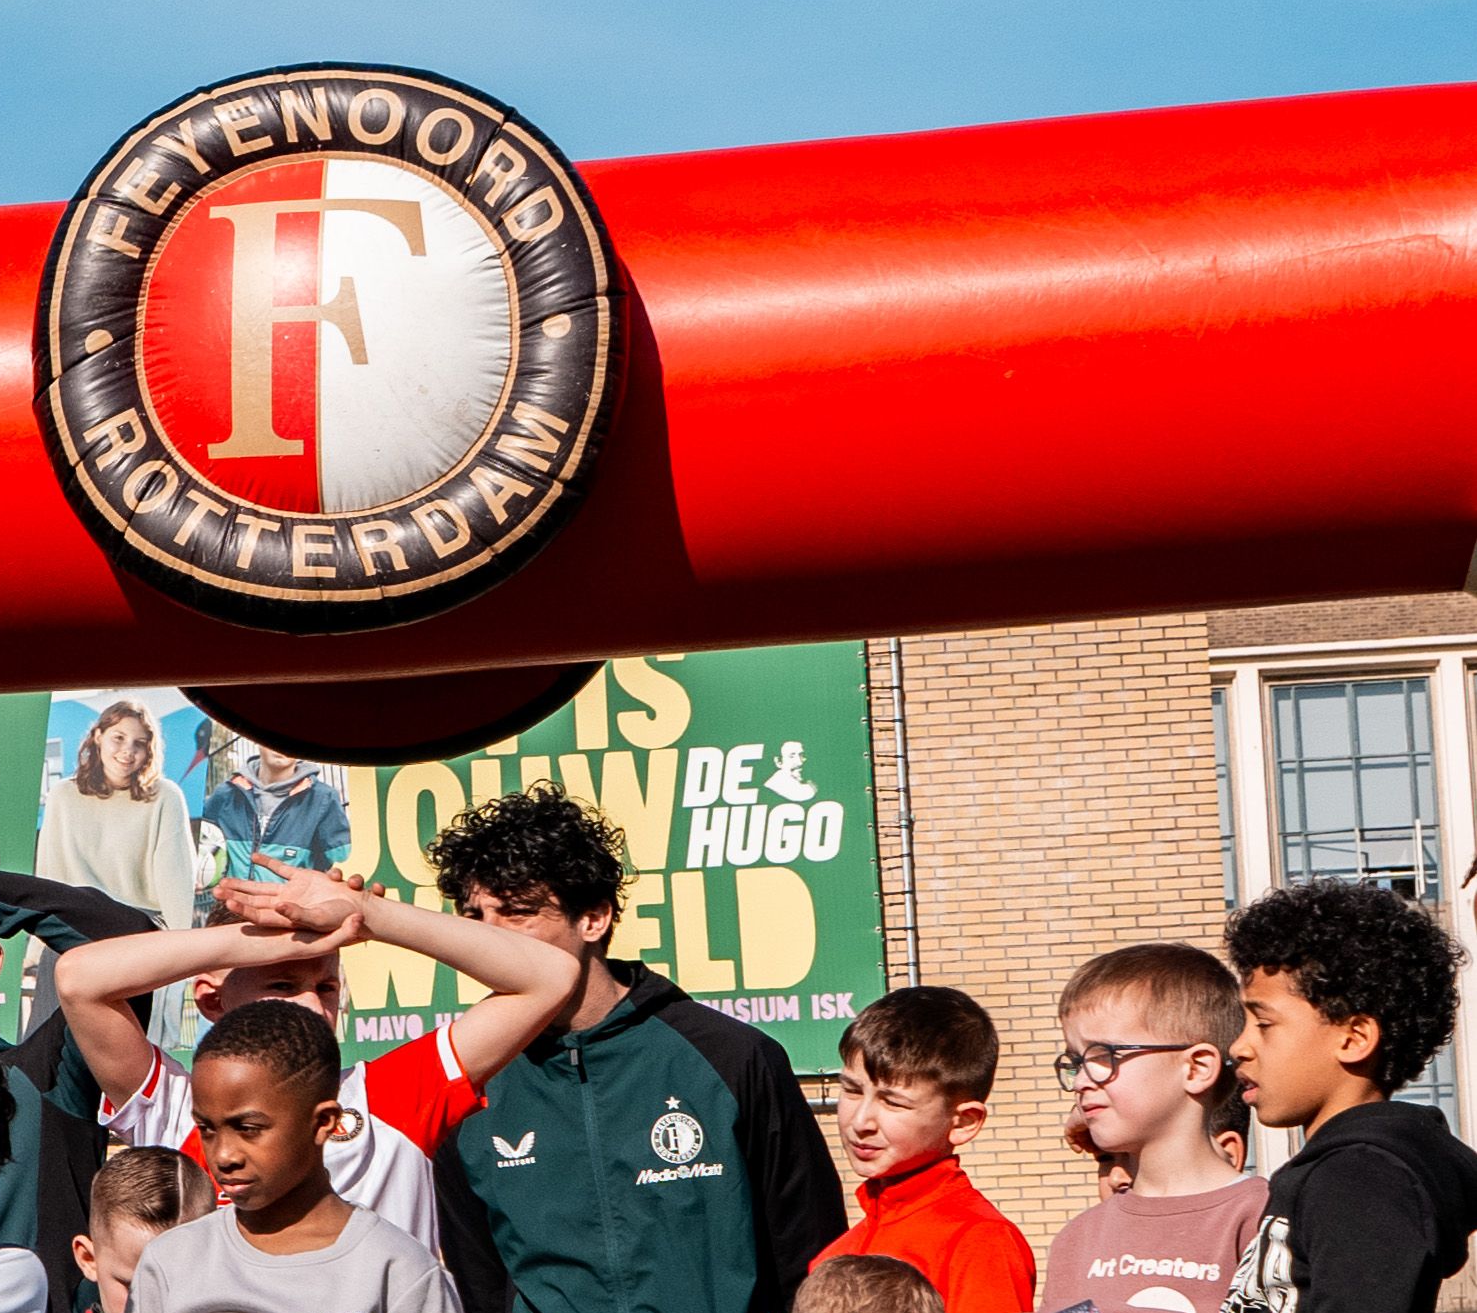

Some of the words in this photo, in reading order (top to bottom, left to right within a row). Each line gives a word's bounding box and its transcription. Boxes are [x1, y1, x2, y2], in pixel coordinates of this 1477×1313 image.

[89, 87, 565, 257] FEYENOORD
[207, 197, 428, 461] F
[82, 401, 571, 579] ROTTERDAM
[682, 743, 765, 808] DE
[686, 800, 845, 869] HUGO
[339, 866, 817, 1010] WELD
[355, 1013, 423, 1042] MAVO
[811, 992, 857, 1020] ISK
[1087, 1258, 1117, 1279] Art
[1119, 1254, 1220, 1281] Creators
